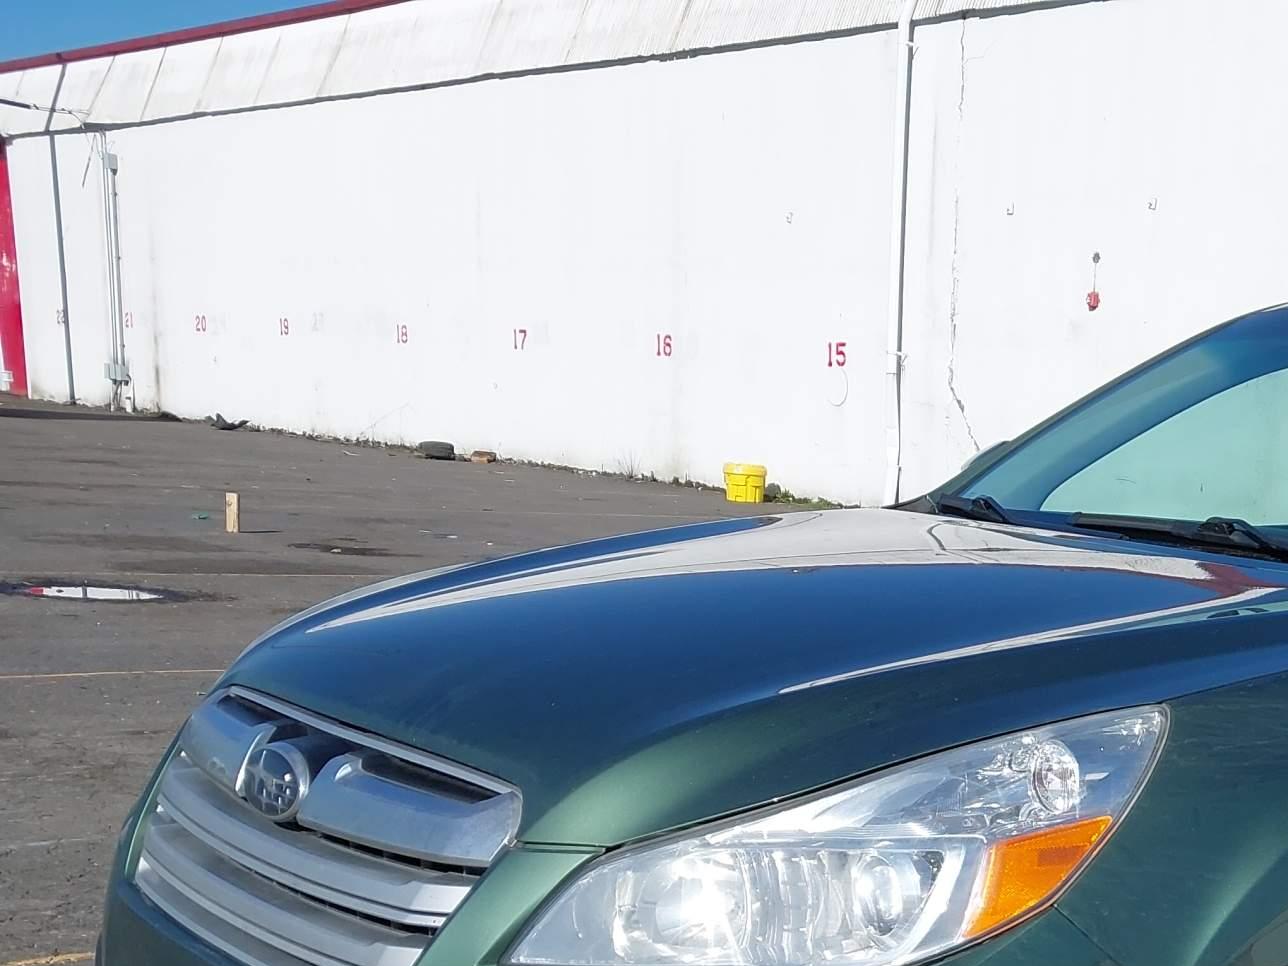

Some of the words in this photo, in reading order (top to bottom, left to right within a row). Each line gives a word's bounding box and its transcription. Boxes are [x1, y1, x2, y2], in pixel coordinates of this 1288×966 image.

[124, 312, 134, 329] 21
[194, 315, 208, 332] 20
[279, 317, 290, 336] 19
[396, 324, 409, 344] 18
[512, 328, 528, 350] 17
[656, 333, 673, 357] 16
[826, 342, 847, 367] 15
